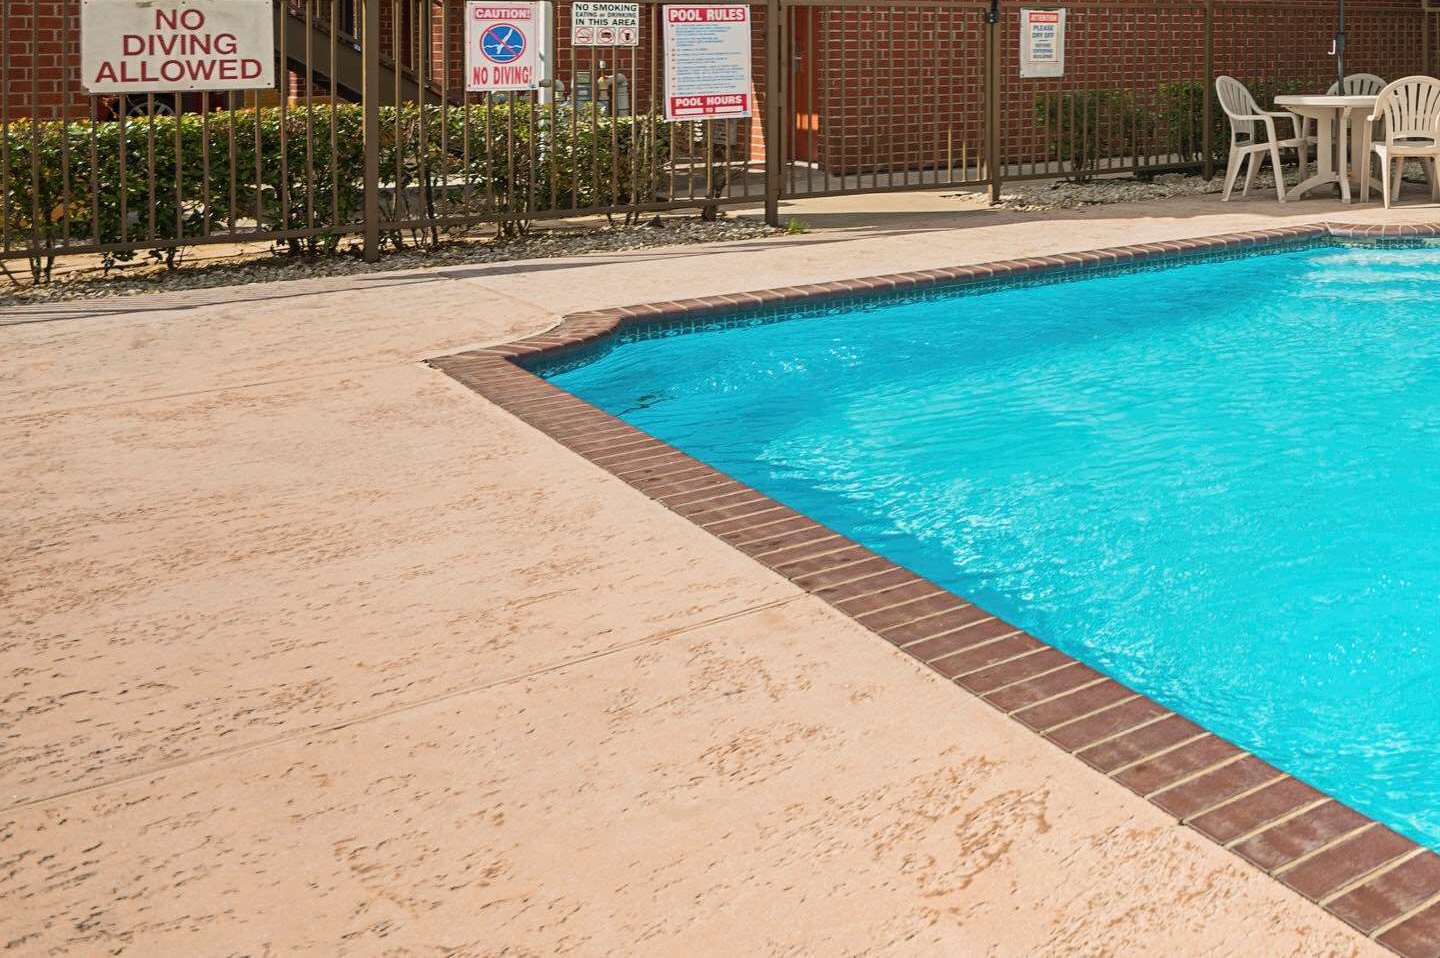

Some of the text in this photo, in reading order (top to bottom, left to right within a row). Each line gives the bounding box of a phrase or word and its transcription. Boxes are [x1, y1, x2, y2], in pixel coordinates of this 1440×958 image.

[155, 9, 205, 30] NO
[476, 9, 530, 18] CAUTION!
[670, 9, 744, 21] POOL RULES
[122, 33, 237, 56] DIVING
[95, 58, 262, 83] ALLOWED
[473, 66, 488, 84] NO
[493, 65, 532, 84] DIVING!
[675, 96, 742, 107] POOL HOURS
